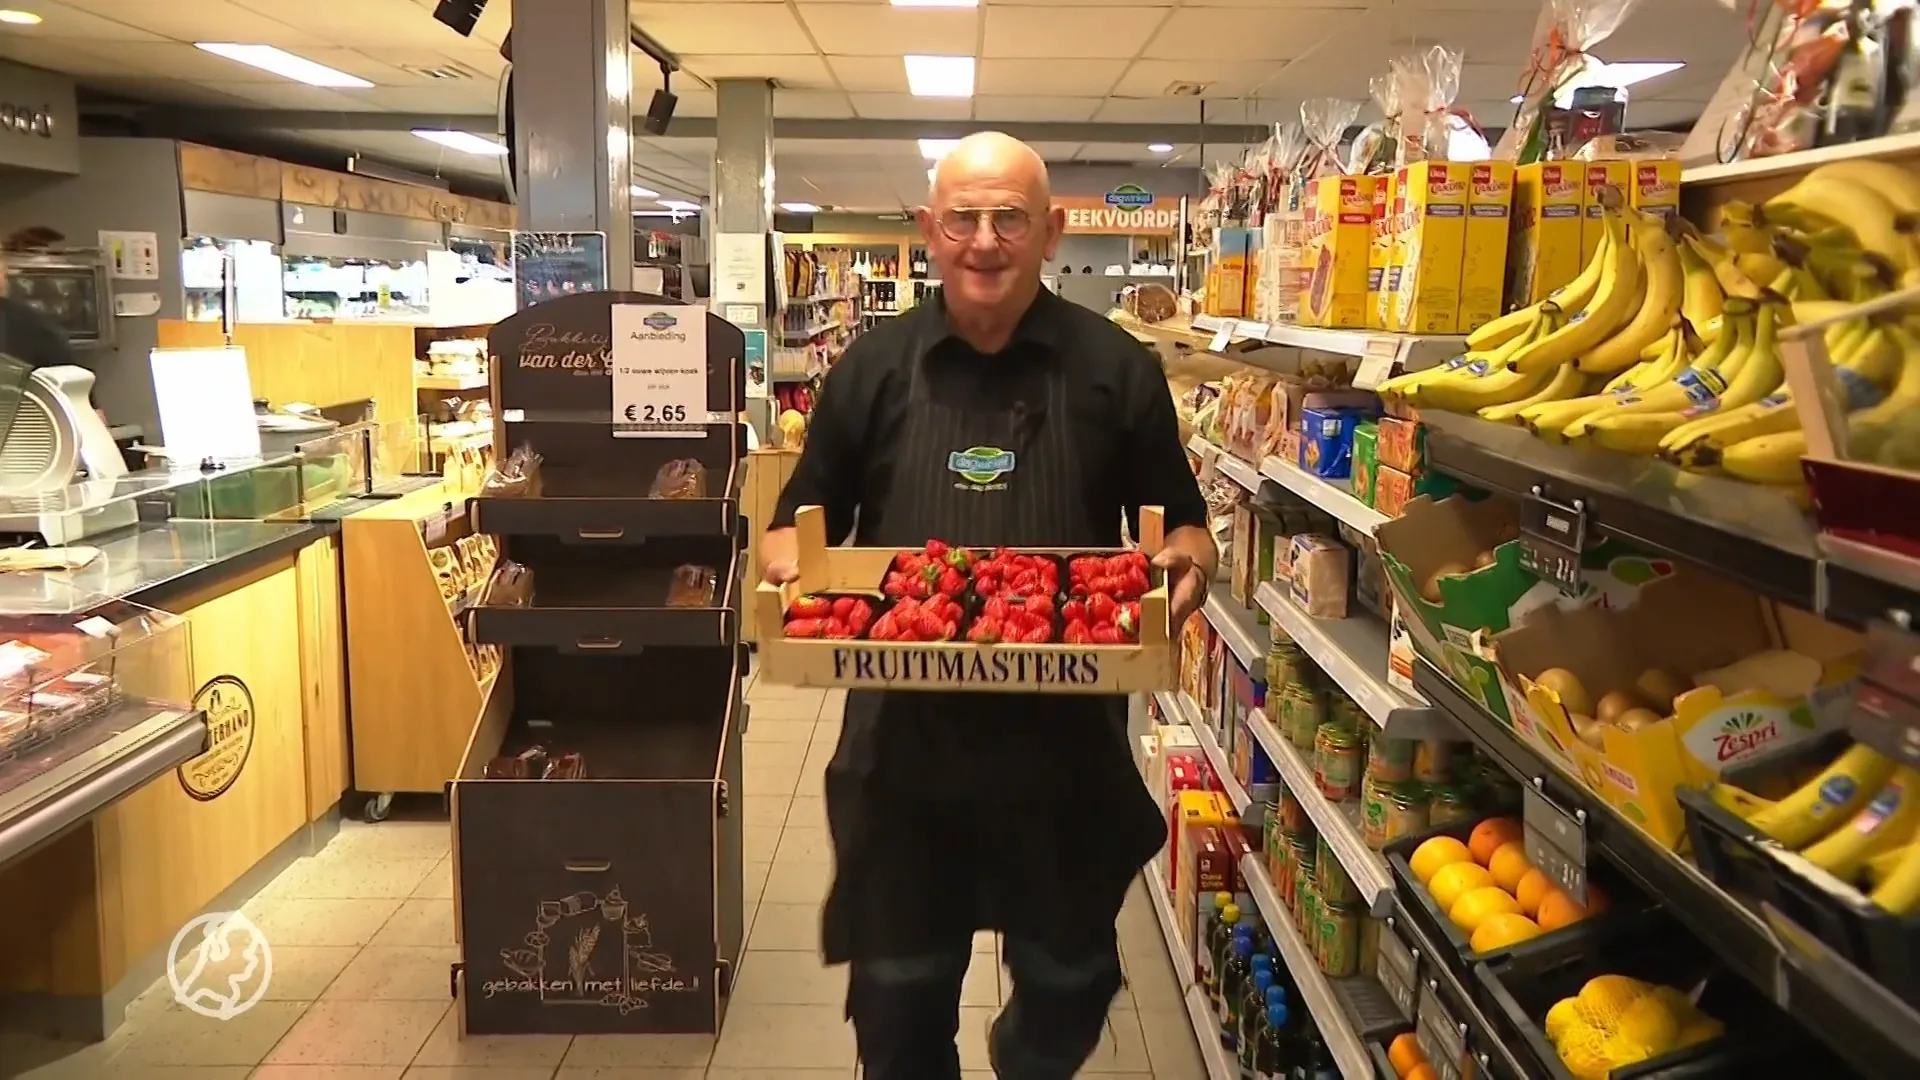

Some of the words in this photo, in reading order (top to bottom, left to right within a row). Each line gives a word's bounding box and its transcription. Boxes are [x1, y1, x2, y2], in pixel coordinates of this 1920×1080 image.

[1064, 209, 1179, 229] EEKVOORDE
[630, 331, 686, 342] Aanbieding
[519, 353, 558, 368] van
[561, 350, 597, 368] der
[624, 404, 637, 421] €
[643, 404, 686, 424] 2,65
[834, 648, 1099, 685] FRUITMASTERS
[1713, 721, 1776, 761] Zespri
[482, 977, 573, 999] gebakken
[584, 977, 621, 991] met
